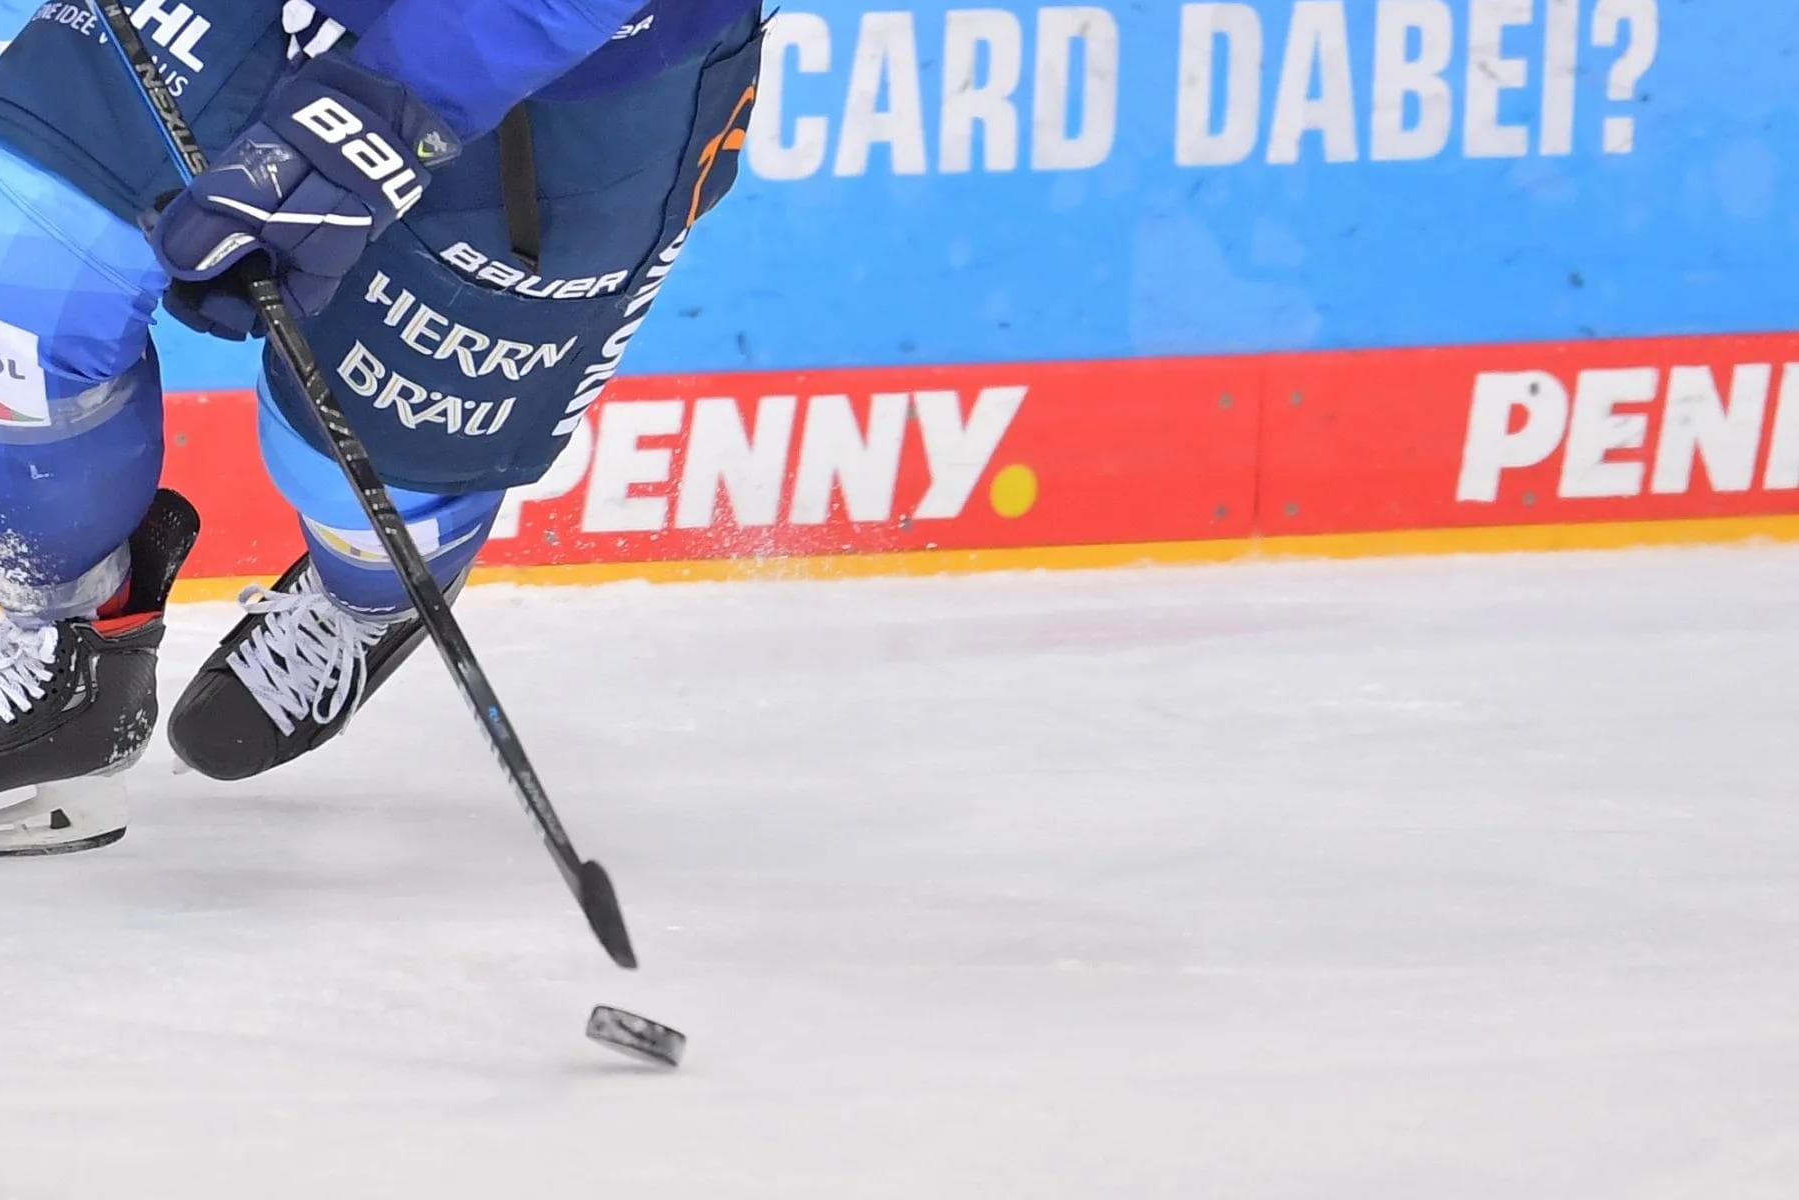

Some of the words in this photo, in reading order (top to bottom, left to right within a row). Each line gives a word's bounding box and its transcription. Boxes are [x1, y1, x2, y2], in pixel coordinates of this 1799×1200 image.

[135, 61, 211, 176] NEXUS
[439, 241, 629, 299] BAUER
[363, 269, 579, 381] HERRN
[336, 338, 517, 437] BRÄU
